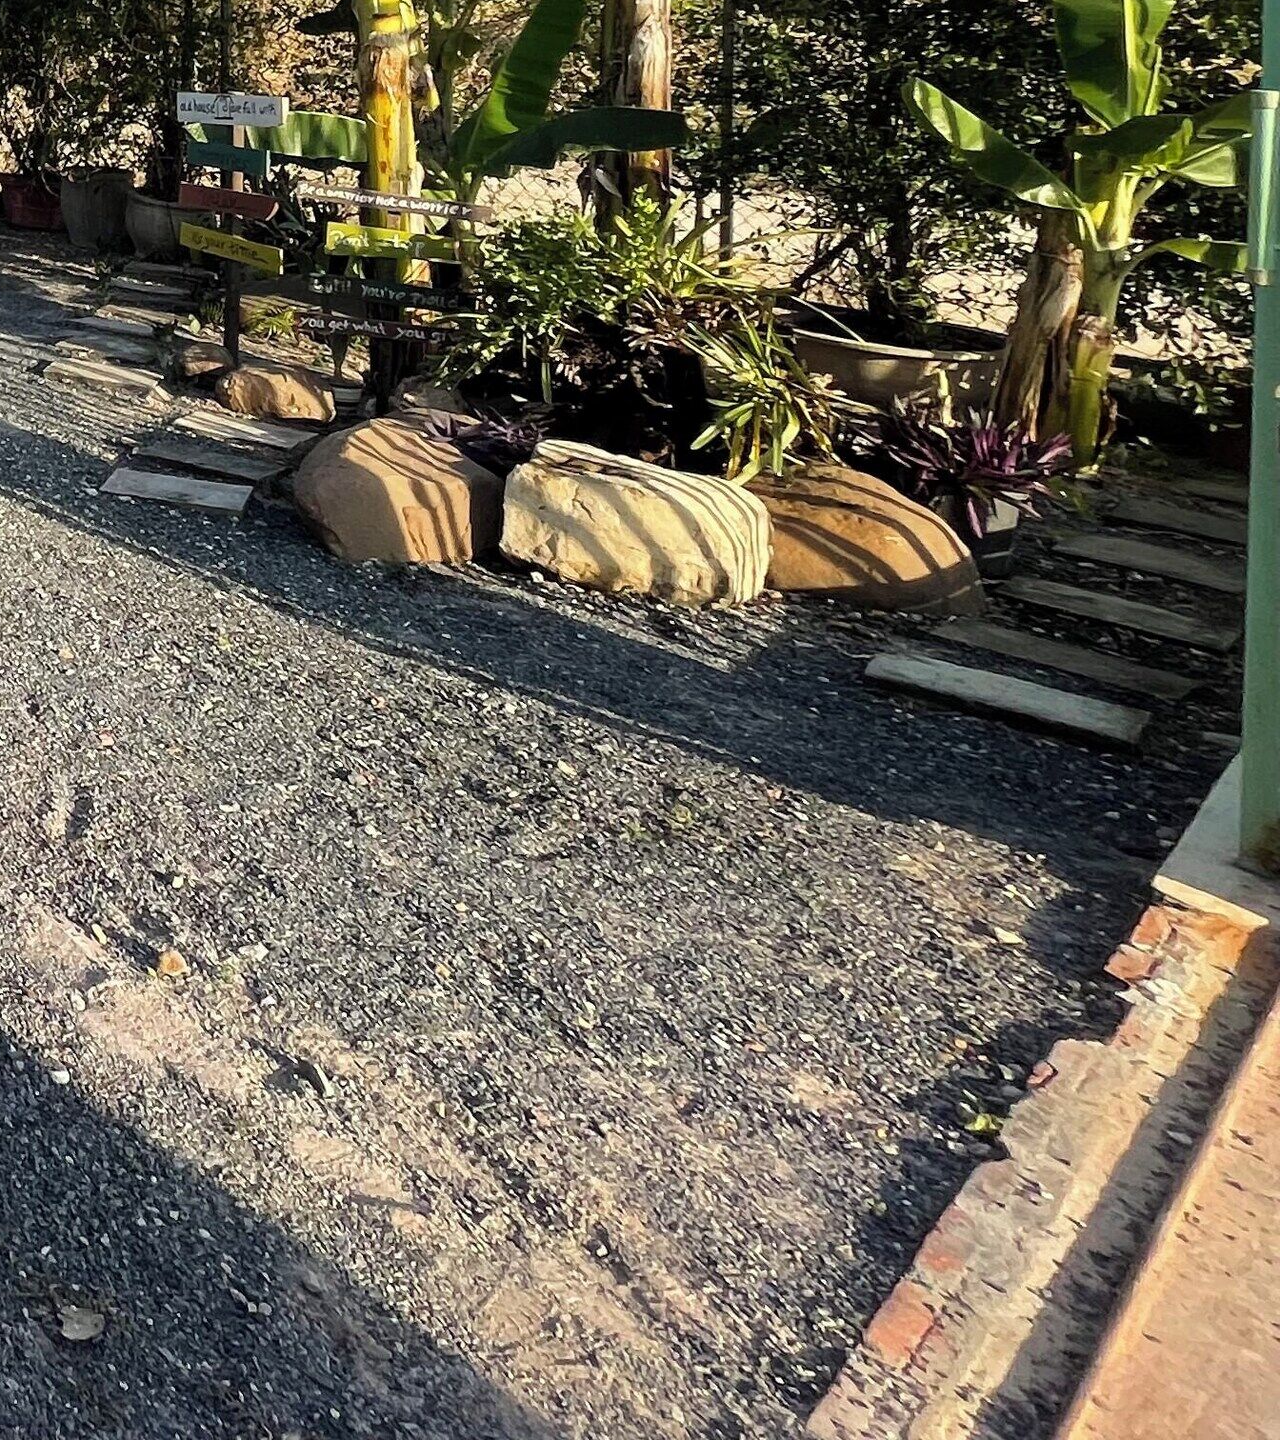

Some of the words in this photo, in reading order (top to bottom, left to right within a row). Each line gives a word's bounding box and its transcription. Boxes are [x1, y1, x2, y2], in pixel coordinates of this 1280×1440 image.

[398, 199, 410, 208] a
[410, 199, 471, 216] worrier
[297, 316, 325, 329] you
[328, 318, 349, 334] get
[351, 320, 387, 336] what
[395, 326, 427, 340] you
